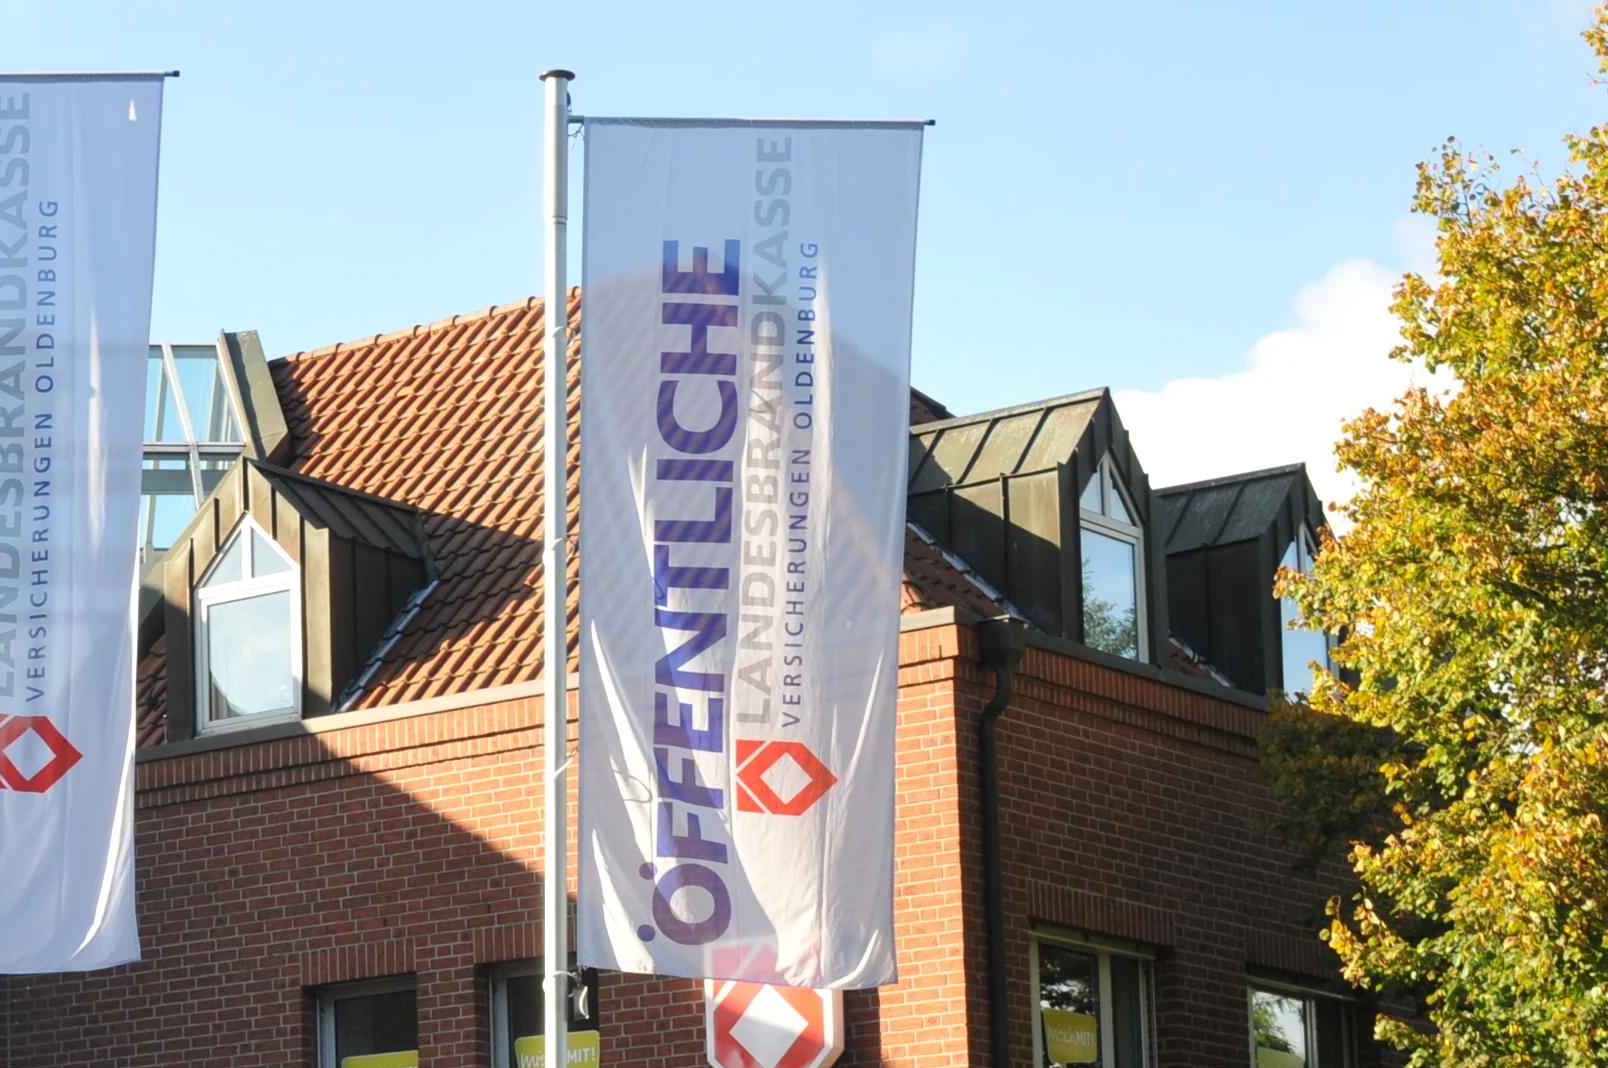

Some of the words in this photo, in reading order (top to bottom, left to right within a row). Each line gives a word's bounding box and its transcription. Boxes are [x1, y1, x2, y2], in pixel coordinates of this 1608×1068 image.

[35, 200, 59, 394] OLDENBURG
[735, 136, 792, 725] LANDESBRANDKASSE
[793, 241, 820, 430] OLDENBURG
[25, 411, 54, 703] VERSICHERUNGEN
[636, 238, 740, 947] ÖFFENTLICHE
[782, 447, 812, 728] VERSICHERUNGEN
